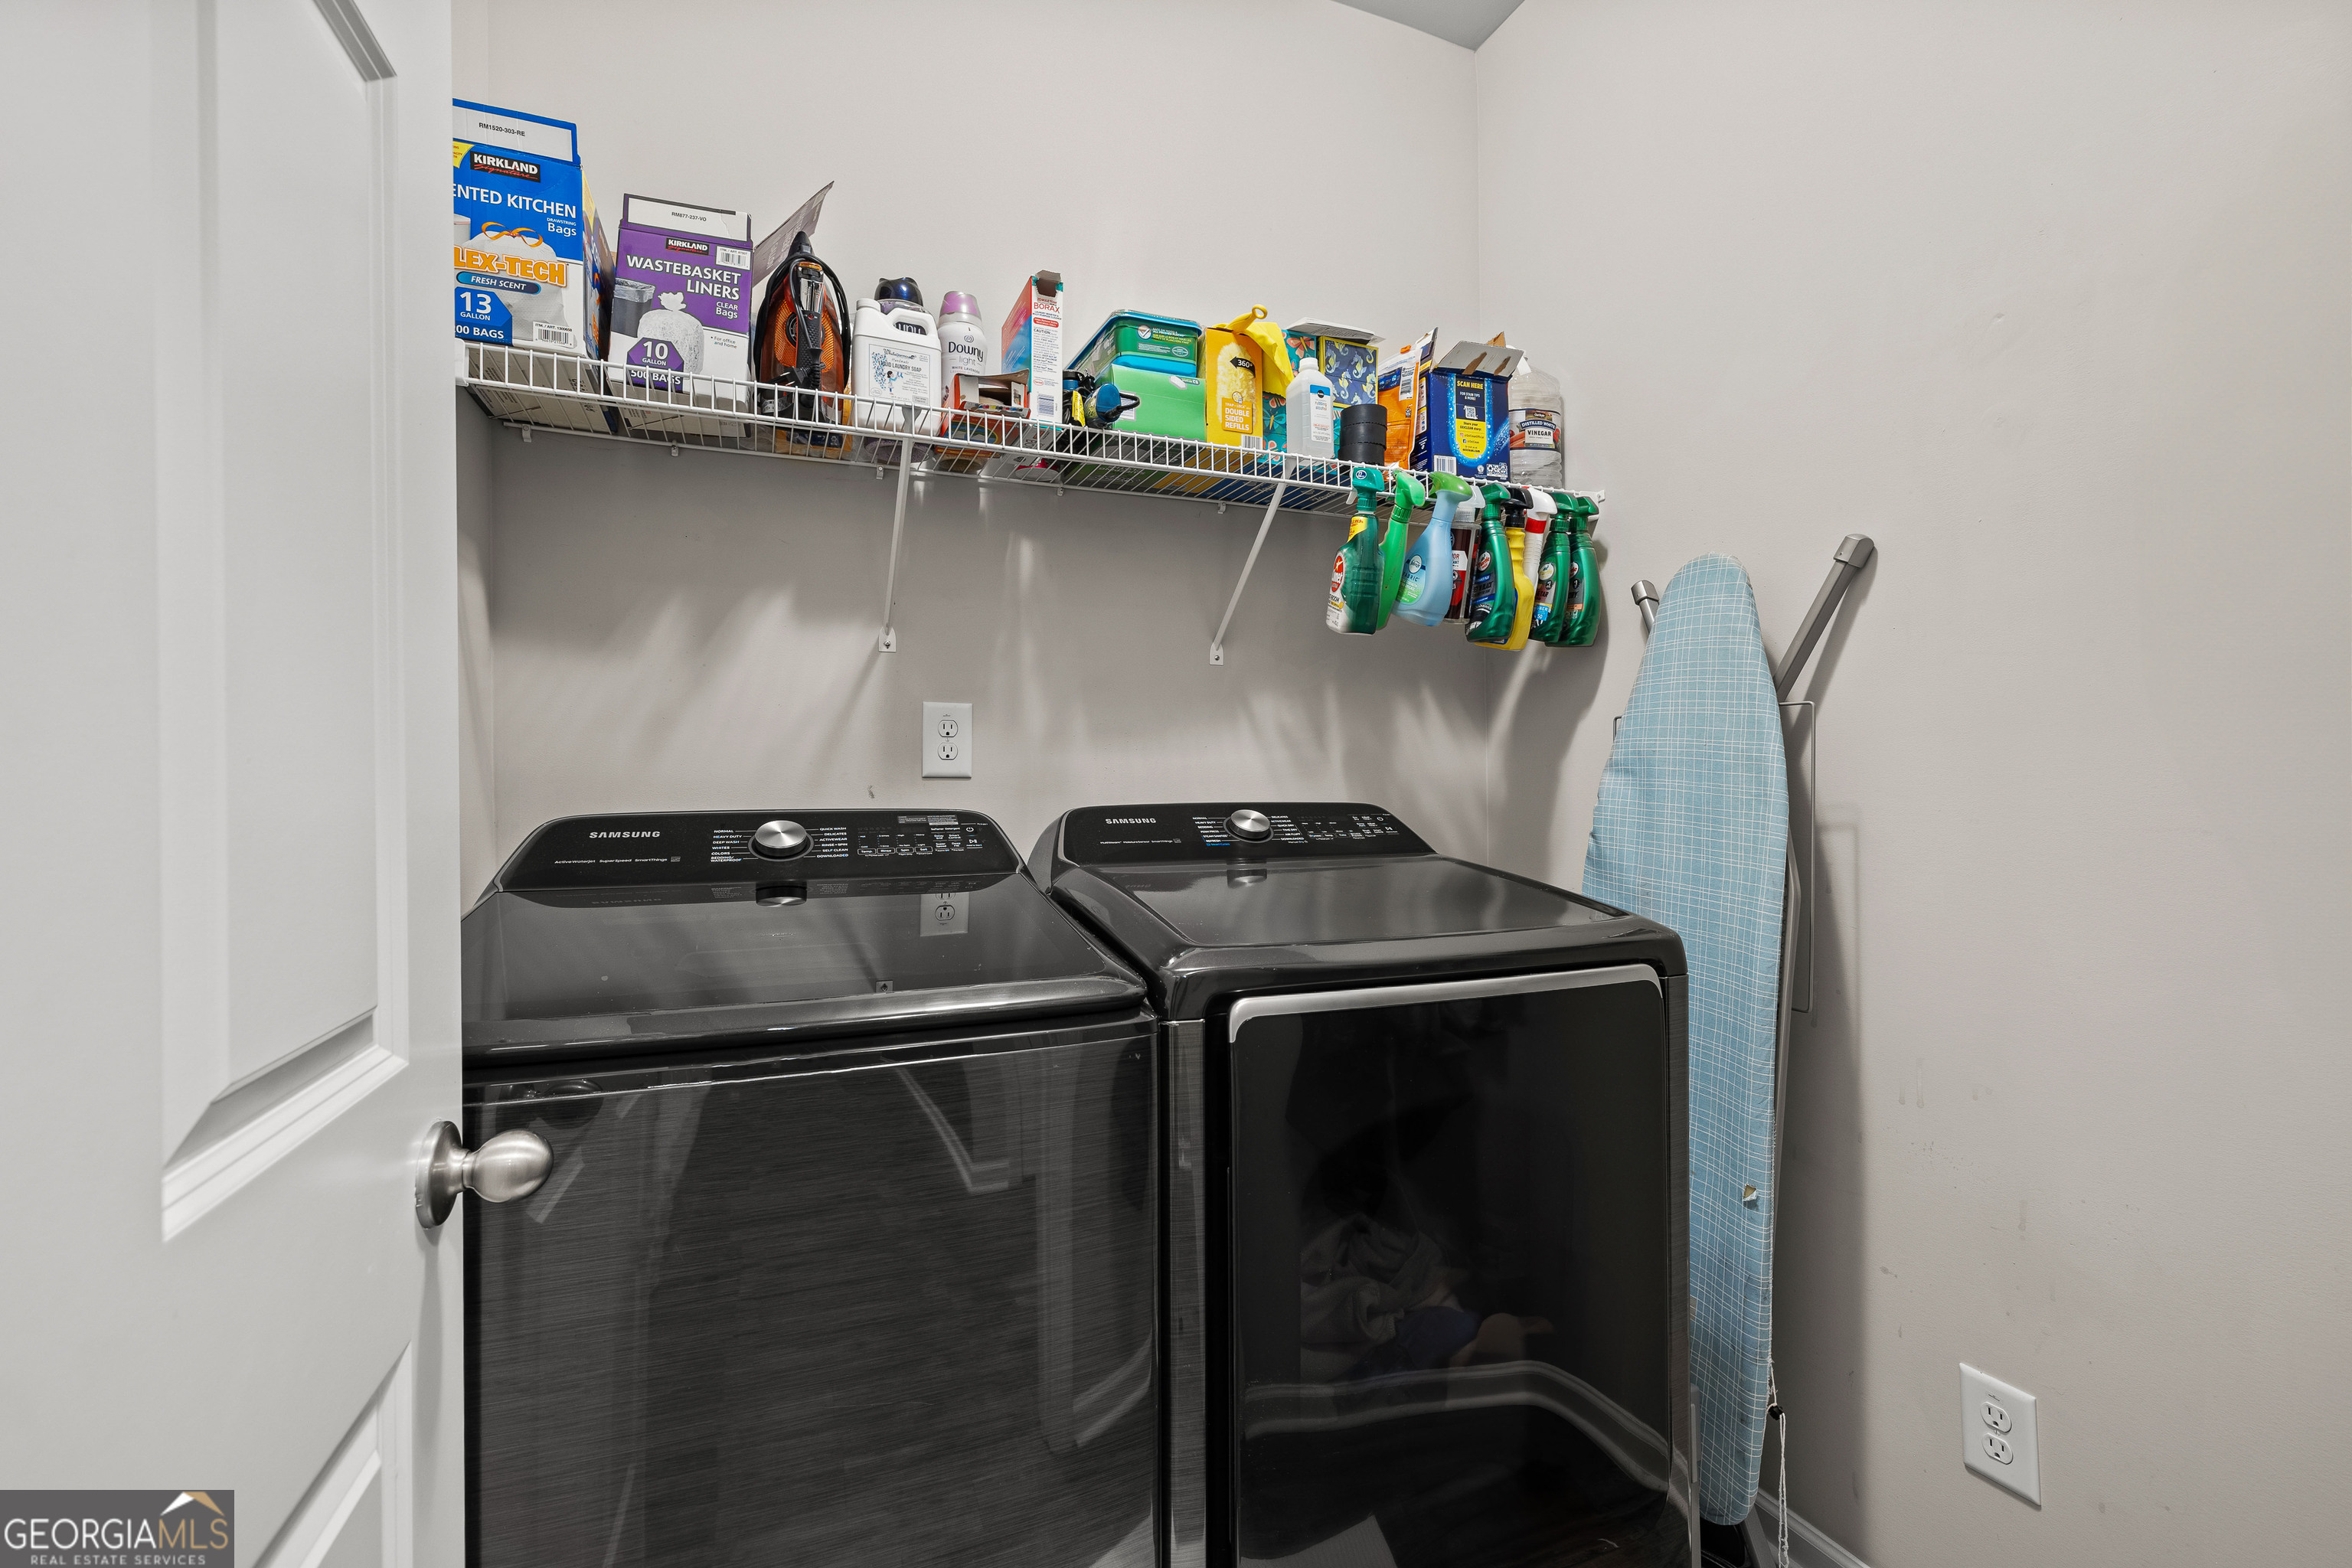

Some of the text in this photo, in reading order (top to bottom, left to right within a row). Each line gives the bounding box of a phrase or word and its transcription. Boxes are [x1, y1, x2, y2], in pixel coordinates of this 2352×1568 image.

[479, 122, 525, 136] RM1520-303-RE
[474, 153, 538, 175] KIRKLAND
[474, 163, 538, 180] Signature
[507, 194, 577, 218] KITCHEN
[547, 217, 577, 226] DRAWSTRING
[671, 212, 707, 221] RM877-237-VO
[547, 222, 577, 237] Bags
[668, 239, 707, 251] KIRKLAND
[626, 255, 741, 285] WASTEBASKET
[471, 276, 527, 290] FRESH SCENT
[687, 279, 740, 300] LINERS
[459, 292, 492, 314] 13
[716, 301, 738, 311] CLEAR
[1034, 302, 1060, 314] BORAX
[460, 312, 491, 321] GALLON
[716, 307, 738, 319] Bags
[454, 325, 505, 339] 00 BAGS
[642, 341, 668, 360] 10
[948, 341, 983, 362] Downy
[642, 357, 666, 366] GALLON
[959, 355, 975, 366] light
[1237, 359, 1253, 368] 360°
[652, 372, 681, 384] BAGS
[1225, 407, 1250, 417] DOUBLE
[1225, 414, 1243, 423] SIDED
[1225, 422, 1250, 431] REFILLS
